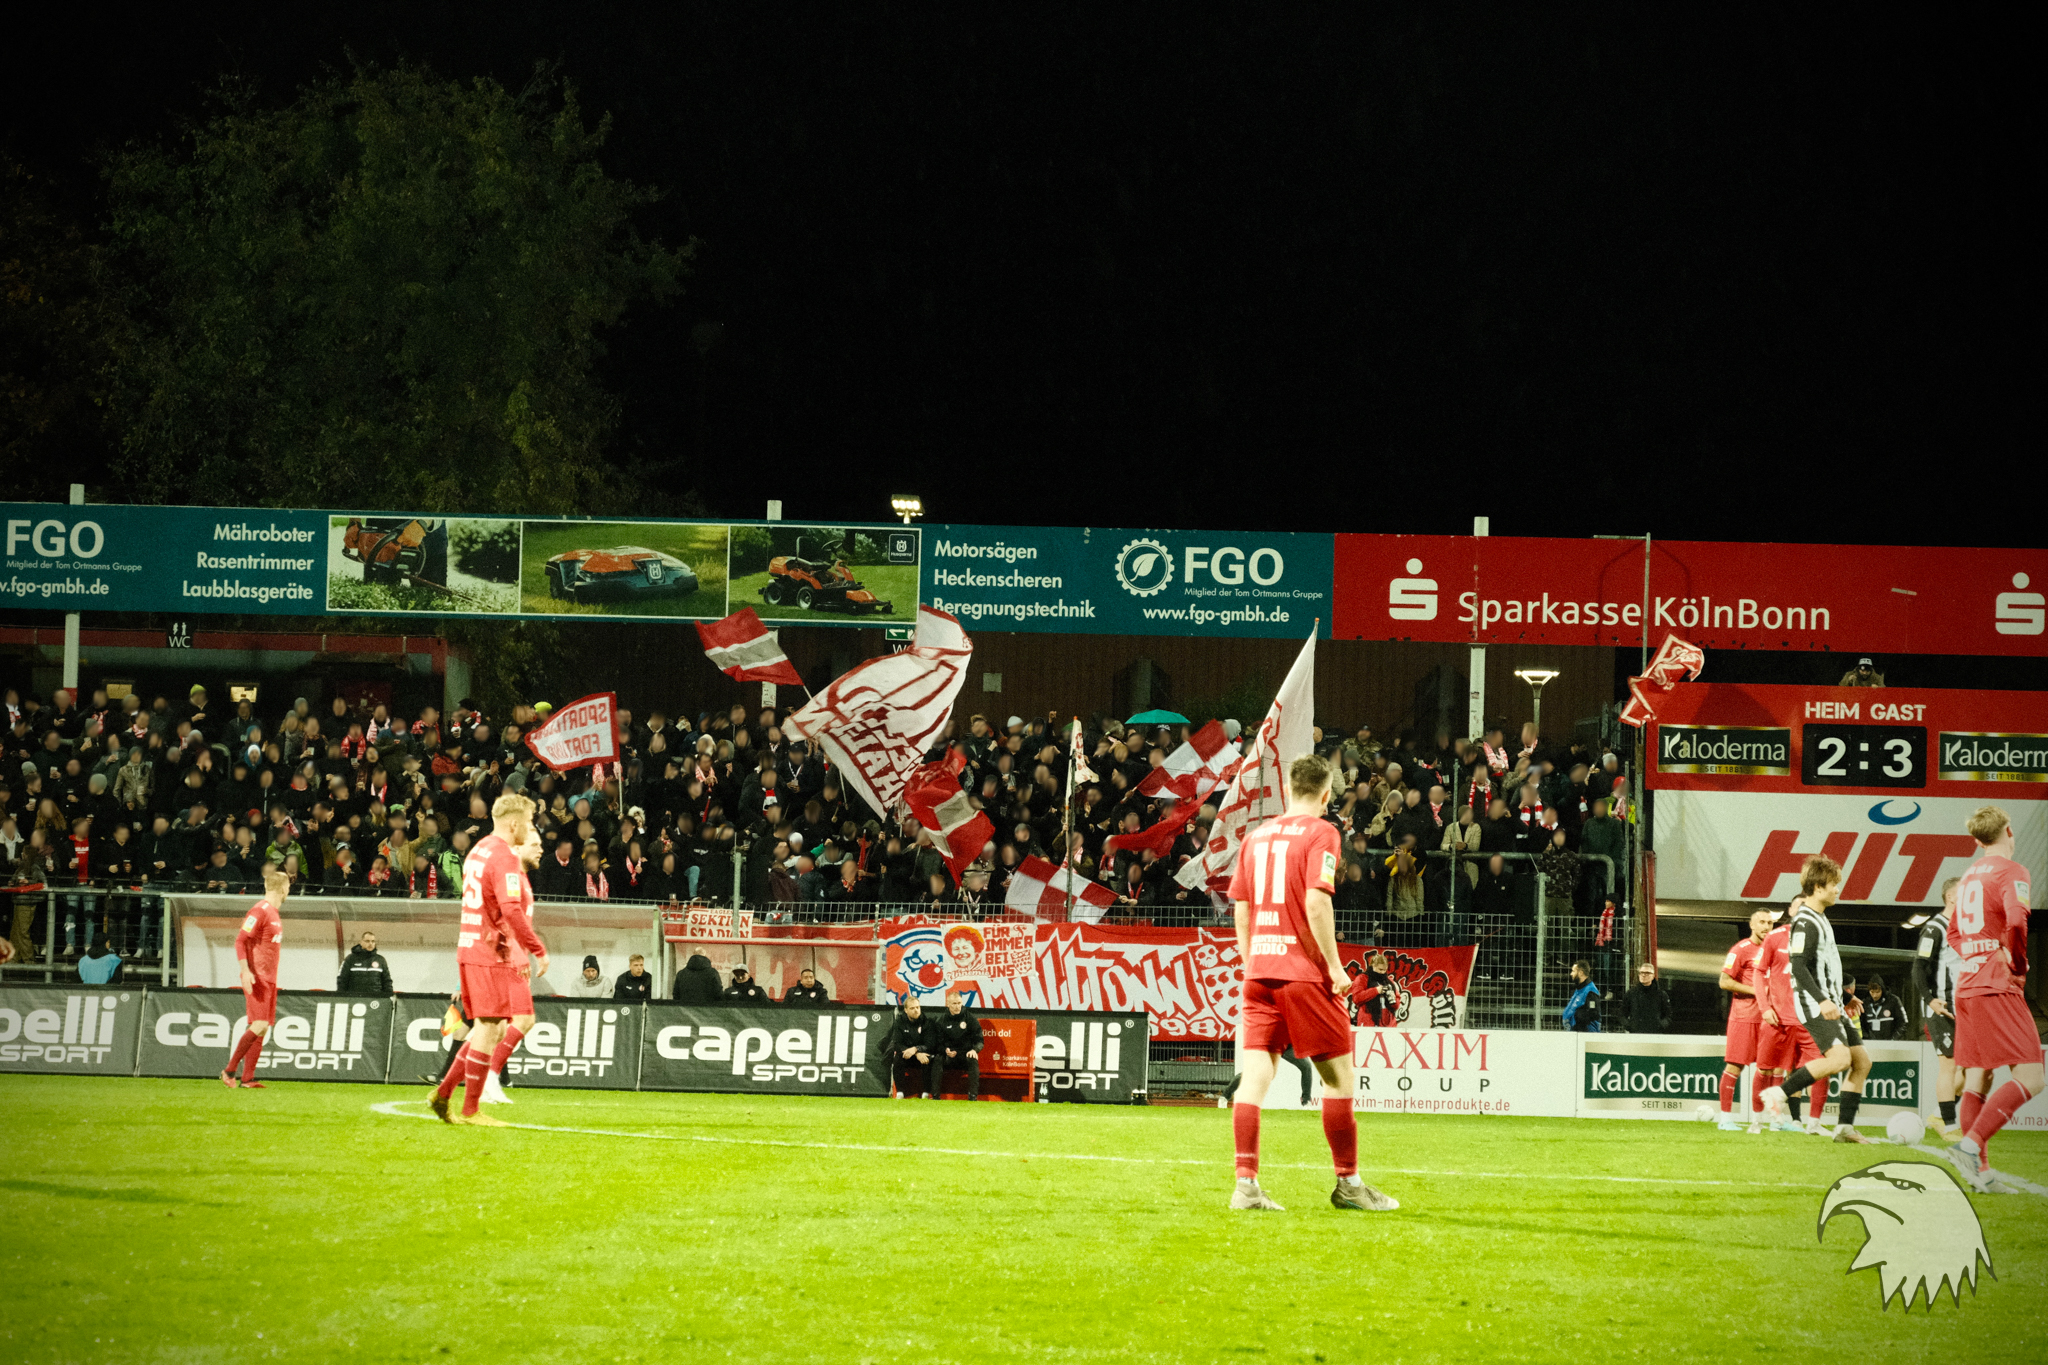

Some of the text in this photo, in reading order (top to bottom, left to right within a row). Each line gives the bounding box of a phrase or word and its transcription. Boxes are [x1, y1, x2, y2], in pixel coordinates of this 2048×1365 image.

[6, 519, 104, 559] FGO
[213, 523, 315, 543] Mähroboter
[196, 551, 315, 571] Rasentrimmer
[934, 540, 1038, 563] Motorsägen
[6, 560, 143, 573] Mitglied der Tom Ortmanns Gruppe
[1184, 547, 1284, 586] FGO
[934, 568, 1063, 588] Heckenscheren
[182, 579, 314, 603] Laubblasgeräte
[1184, 587, 1323, 600] Mitglied der Tom Ortmanns Gruppe
[933, 598, 1096, 621] Beregnungstechnik
[1143, 603, 1290, 625] www.fgo-gmbh.de
[1457, 592, 1831, 631] Sparkasse KölnBonn
[168, 636, 191, 648] WC
[892, 643, 908, 655] W
[1804, 701, 1926, 722] HEIM GAST
[1663, 732, 1786, 761] Kaloderma
[1704, 765, 1722, 773] SEIT
[1253, 840, 1290, 905] 11
[1740, 829, 1980, 903] HIT
[1957, 880, 1985, 936] 19
[691, 913, 751, 928] SEKTIN
[690, 927, 750, 938] STADIN
[983, 924, 1010, 939] FÜR
[985, 935, 1033, 951] IMMER
[985, 952, 1009, 965] BEI
[987, 965, 1015, 979] UNS
[998, 1029, 1012, 1037] do!
[656, 1015, 868, 1076] capelli
[752, 1065, 865, 1084] SPORT
[1032, 1071, 1119, 1090] PORT
[1319, 1076, 1490, 1092] ROUP
[1590, 1059, 1720, 1095] Kaloderm
[1641, 1100, 1683, 1109] SEIT 1881
